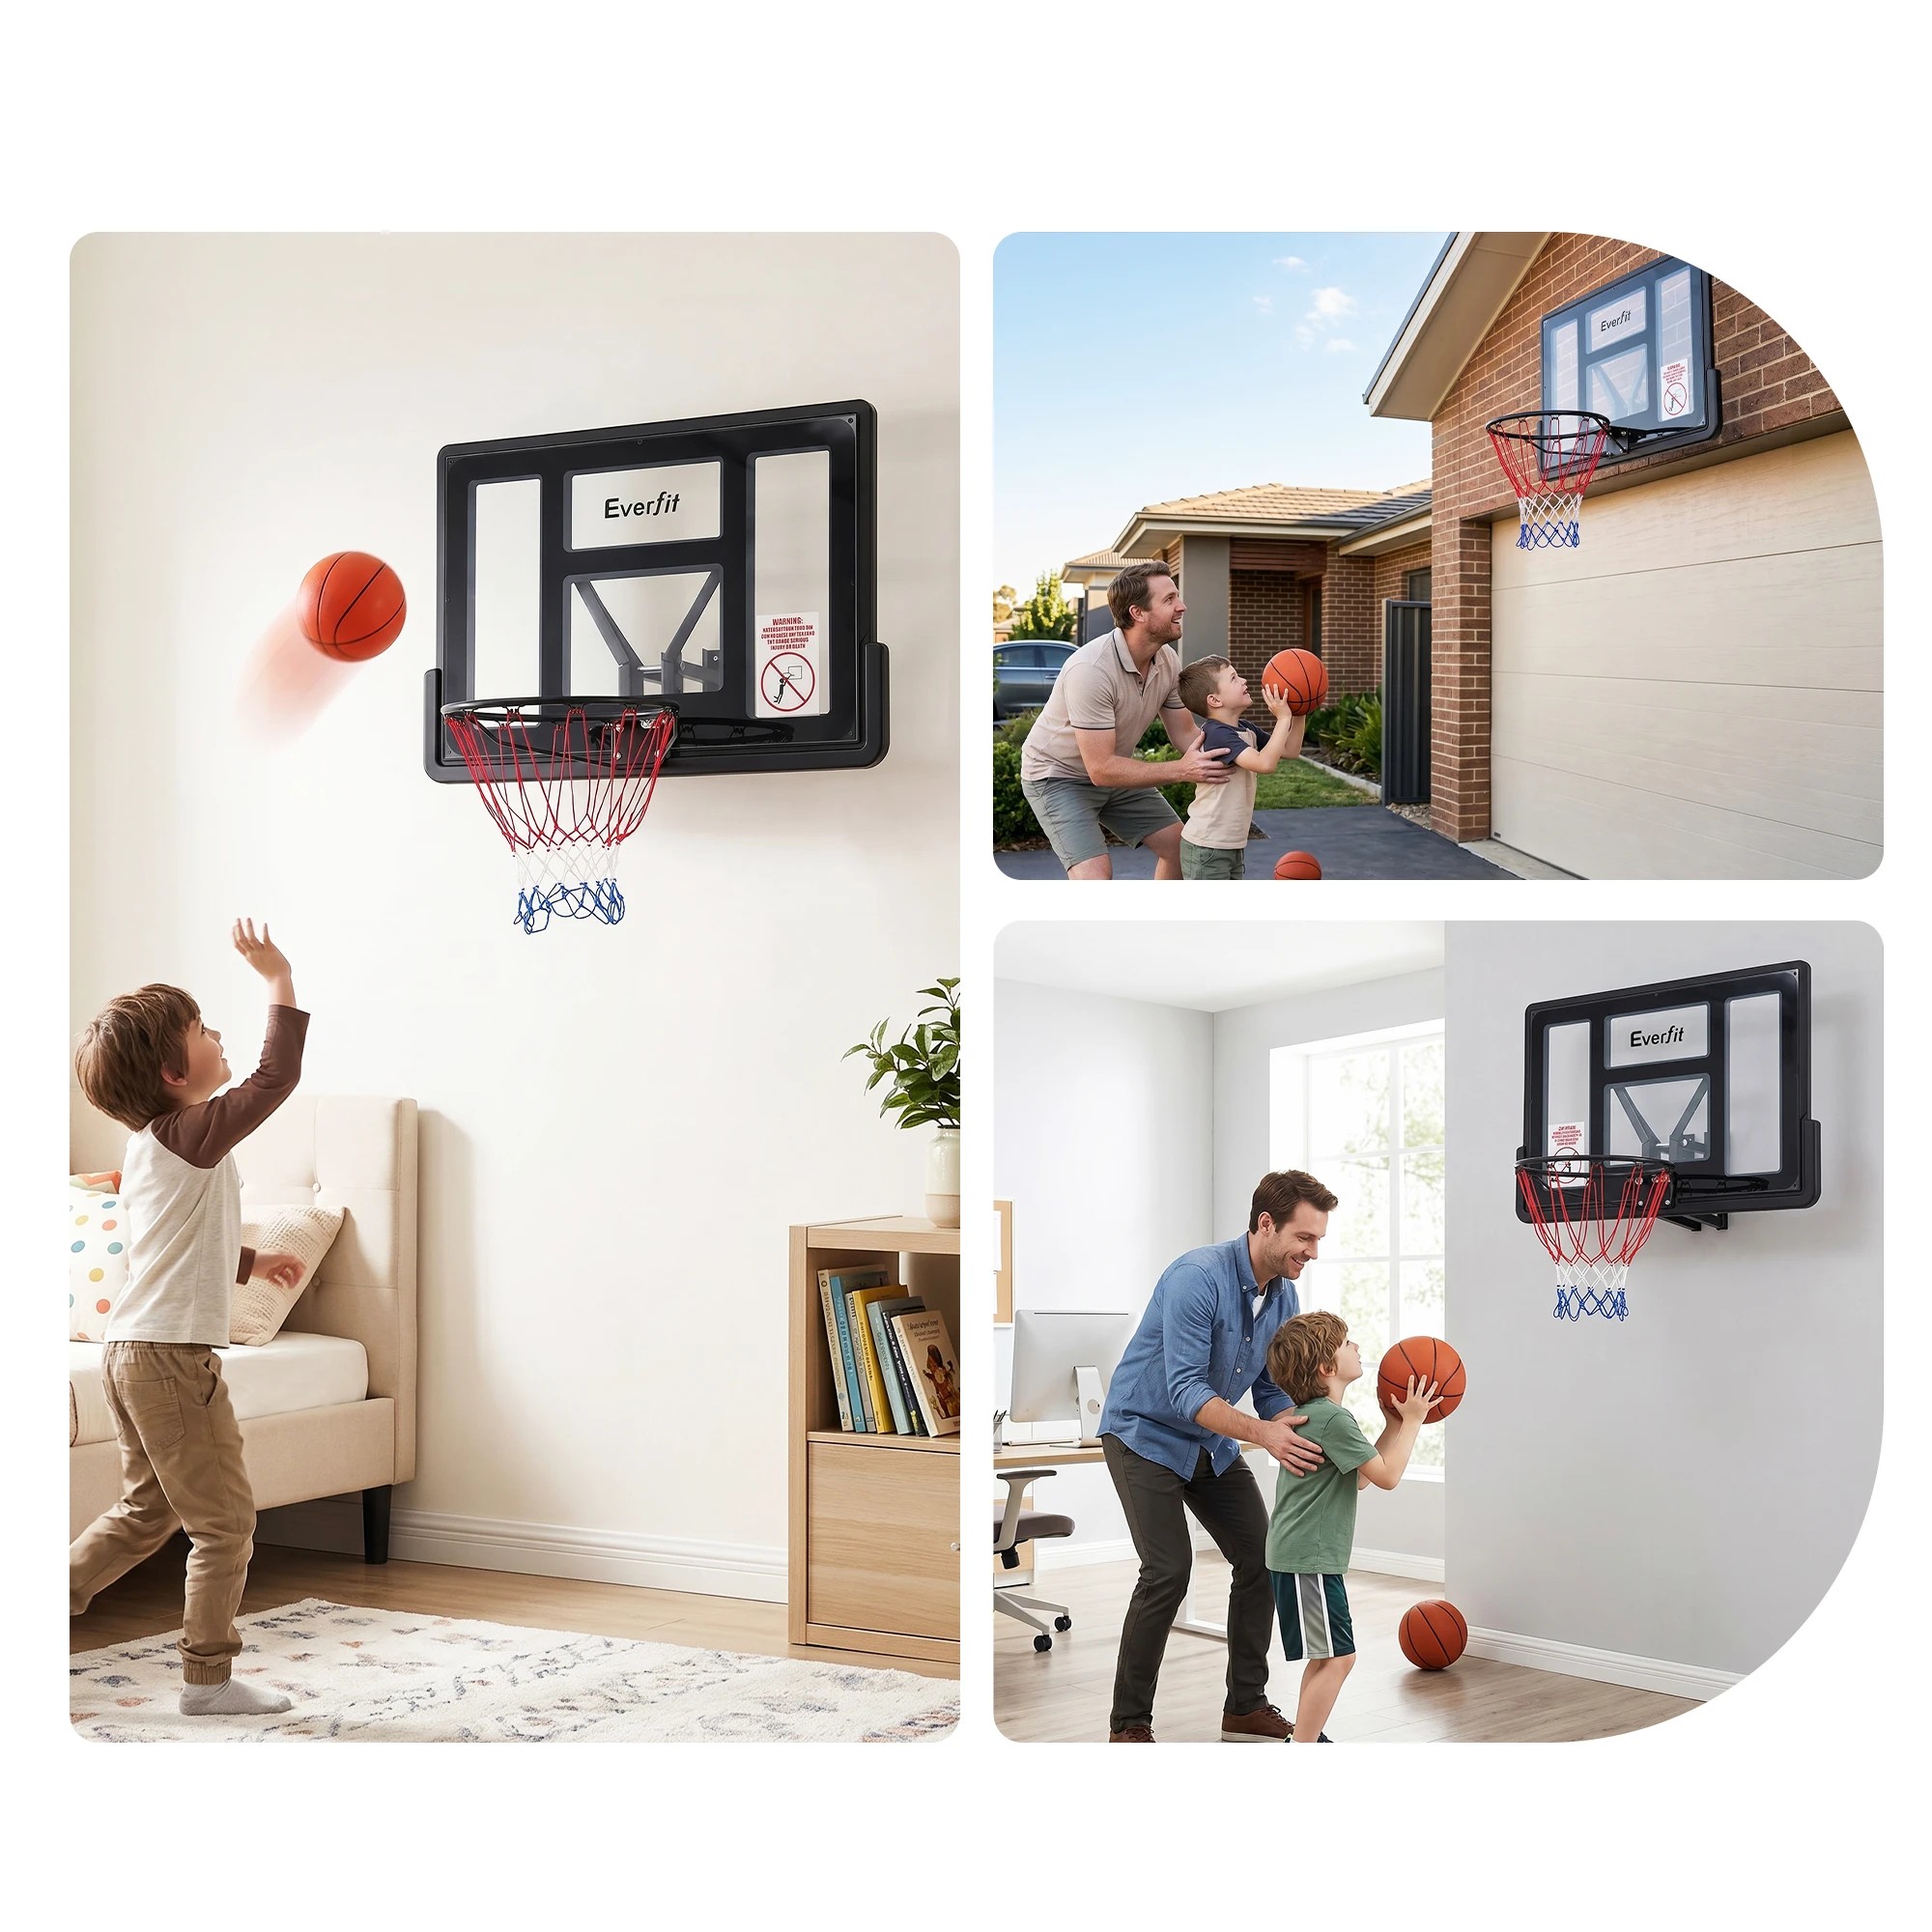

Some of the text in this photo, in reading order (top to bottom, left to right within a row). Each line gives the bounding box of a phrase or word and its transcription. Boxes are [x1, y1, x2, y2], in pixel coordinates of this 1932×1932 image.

[1601, 309, 1632, 332] Everfit
[605, 491, 680, 519] Everfit
[1630, 1025, 1685, 1047] Everfit
